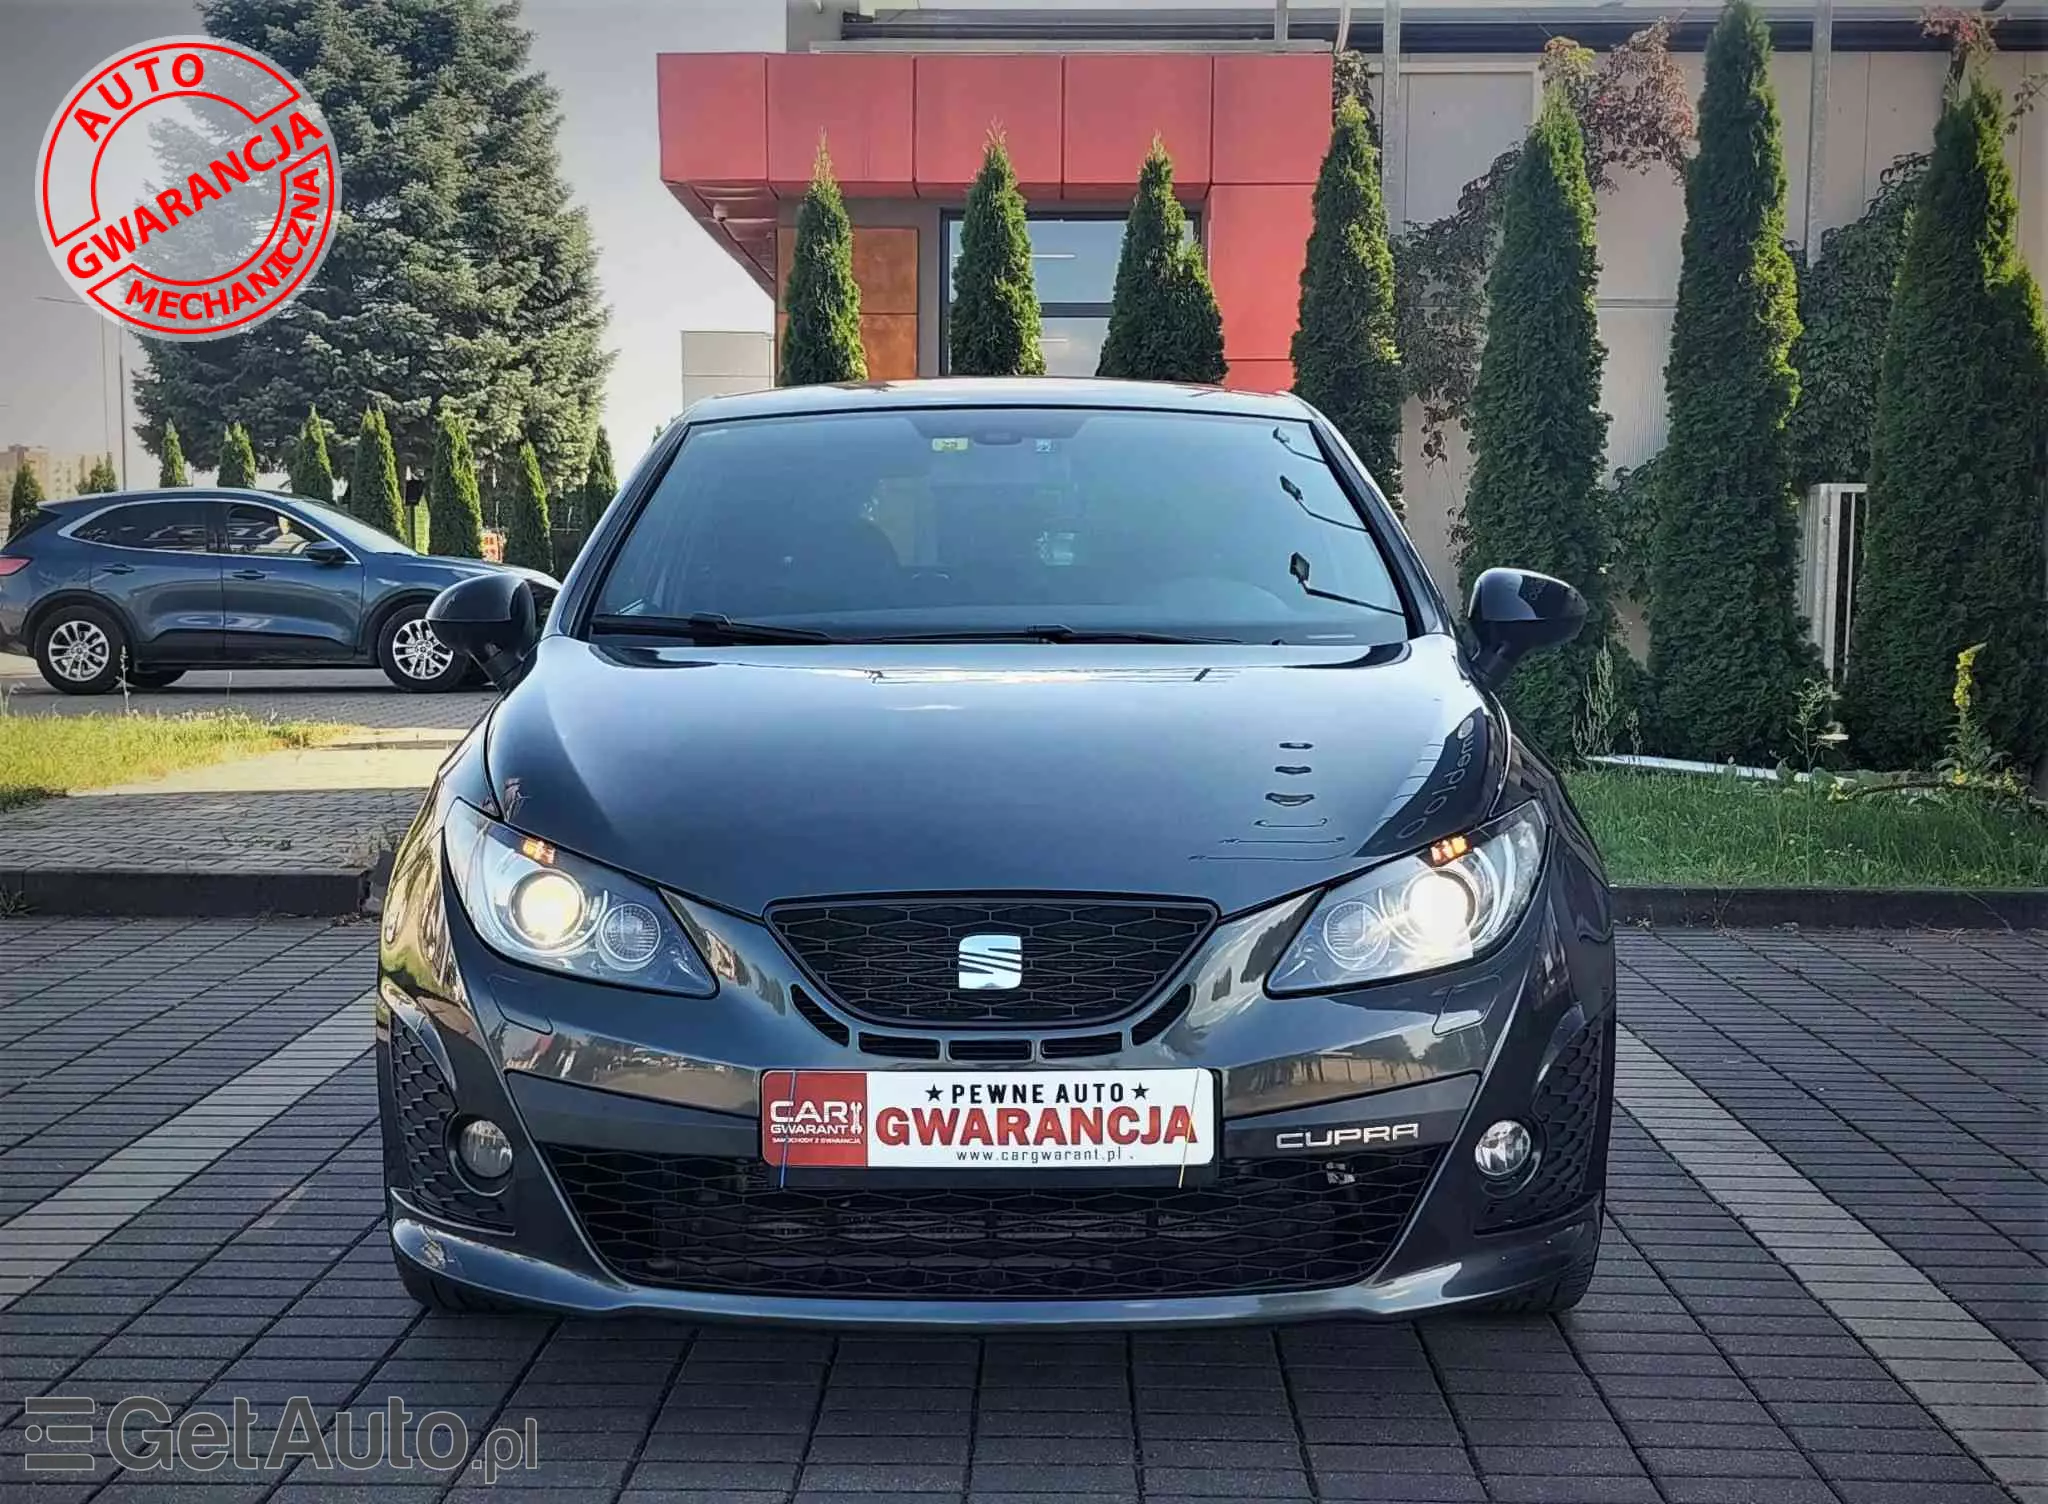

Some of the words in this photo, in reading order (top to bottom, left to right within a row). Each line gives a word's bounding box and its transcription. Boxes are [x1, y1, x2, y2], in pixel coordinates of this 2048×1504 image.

[952, 1084, 1044, 1104] PEWNE
[1055, 1083, 1125, 1103] AUTO
[770, 1101, 848, 1123] CAR
[770, 1125, 848, 1134] GWARANT
[875, 1105, 1198, 1146] GWARANCJA
[1276, 1123, 1421, 1149] CUPRA
[956, 1147, 1121, 1164] www.cargwarant.pl
